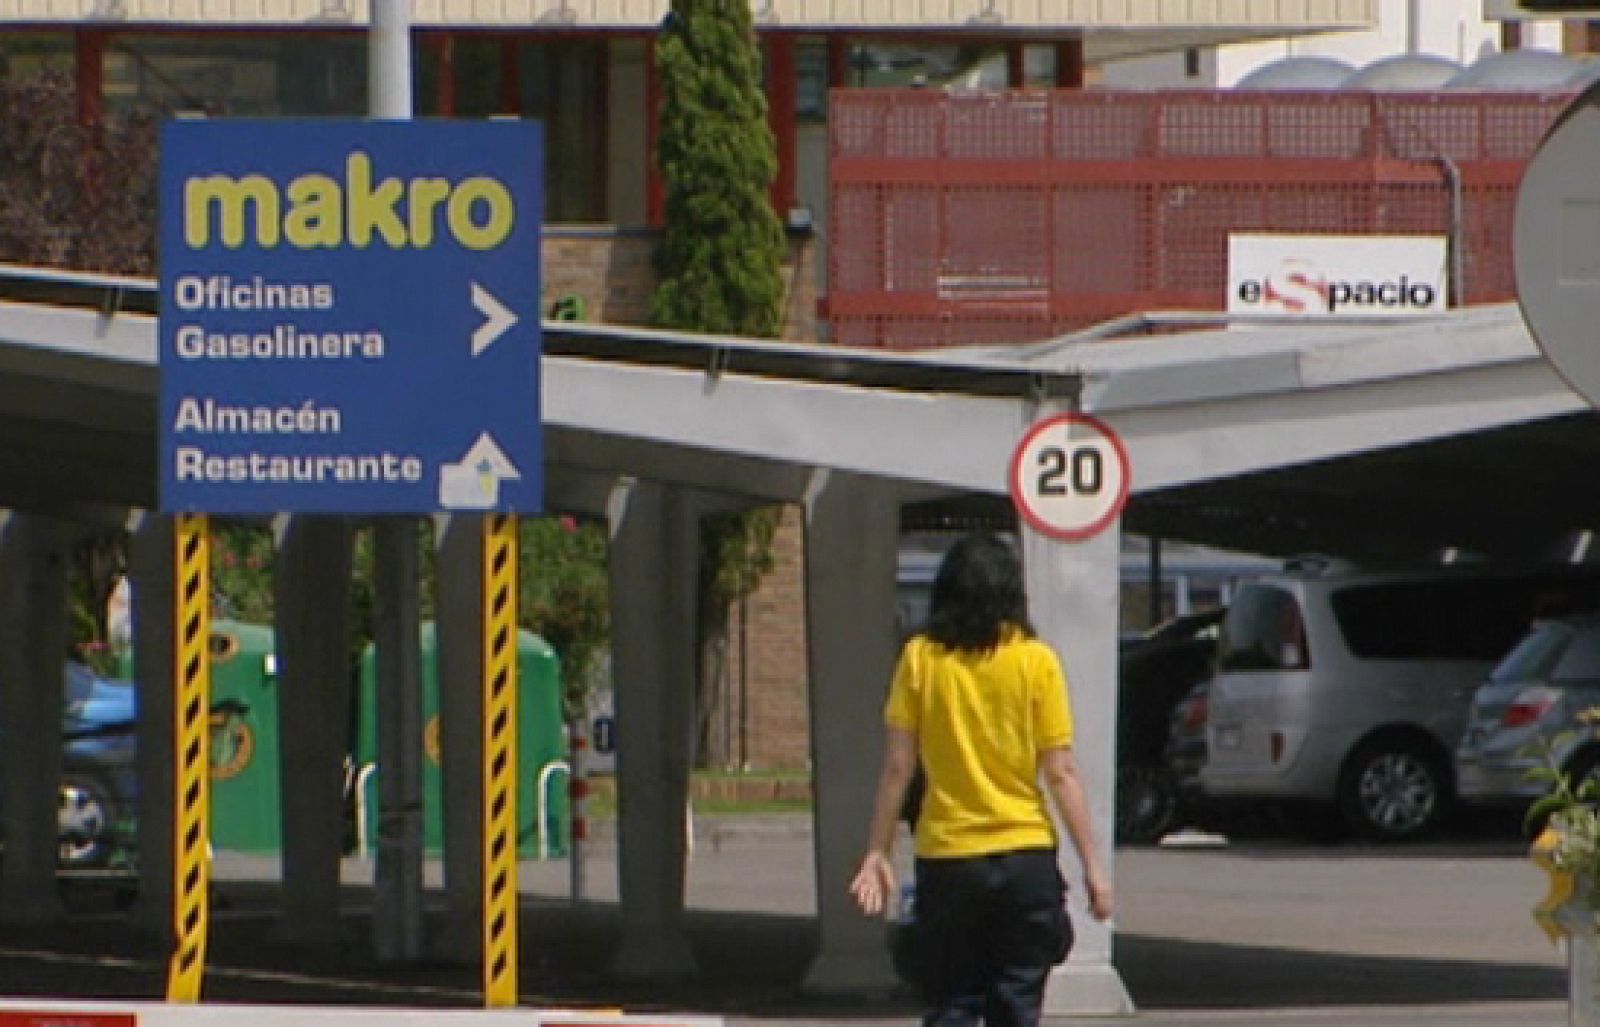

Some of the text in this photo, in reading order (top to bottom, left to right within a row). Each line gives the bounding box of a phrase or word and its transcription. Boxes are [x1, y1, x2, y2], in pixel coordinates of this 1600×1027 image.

[185, 151, 515, 250] makro
[175, 276, 334, 309] Oficinas
[175, 325, 385, 358] Gasolinera
[175, 399, 342, 433] Almacén
[175, 447, 423, 482] Restaurante
[1037, 446, 1103, 496] 20
